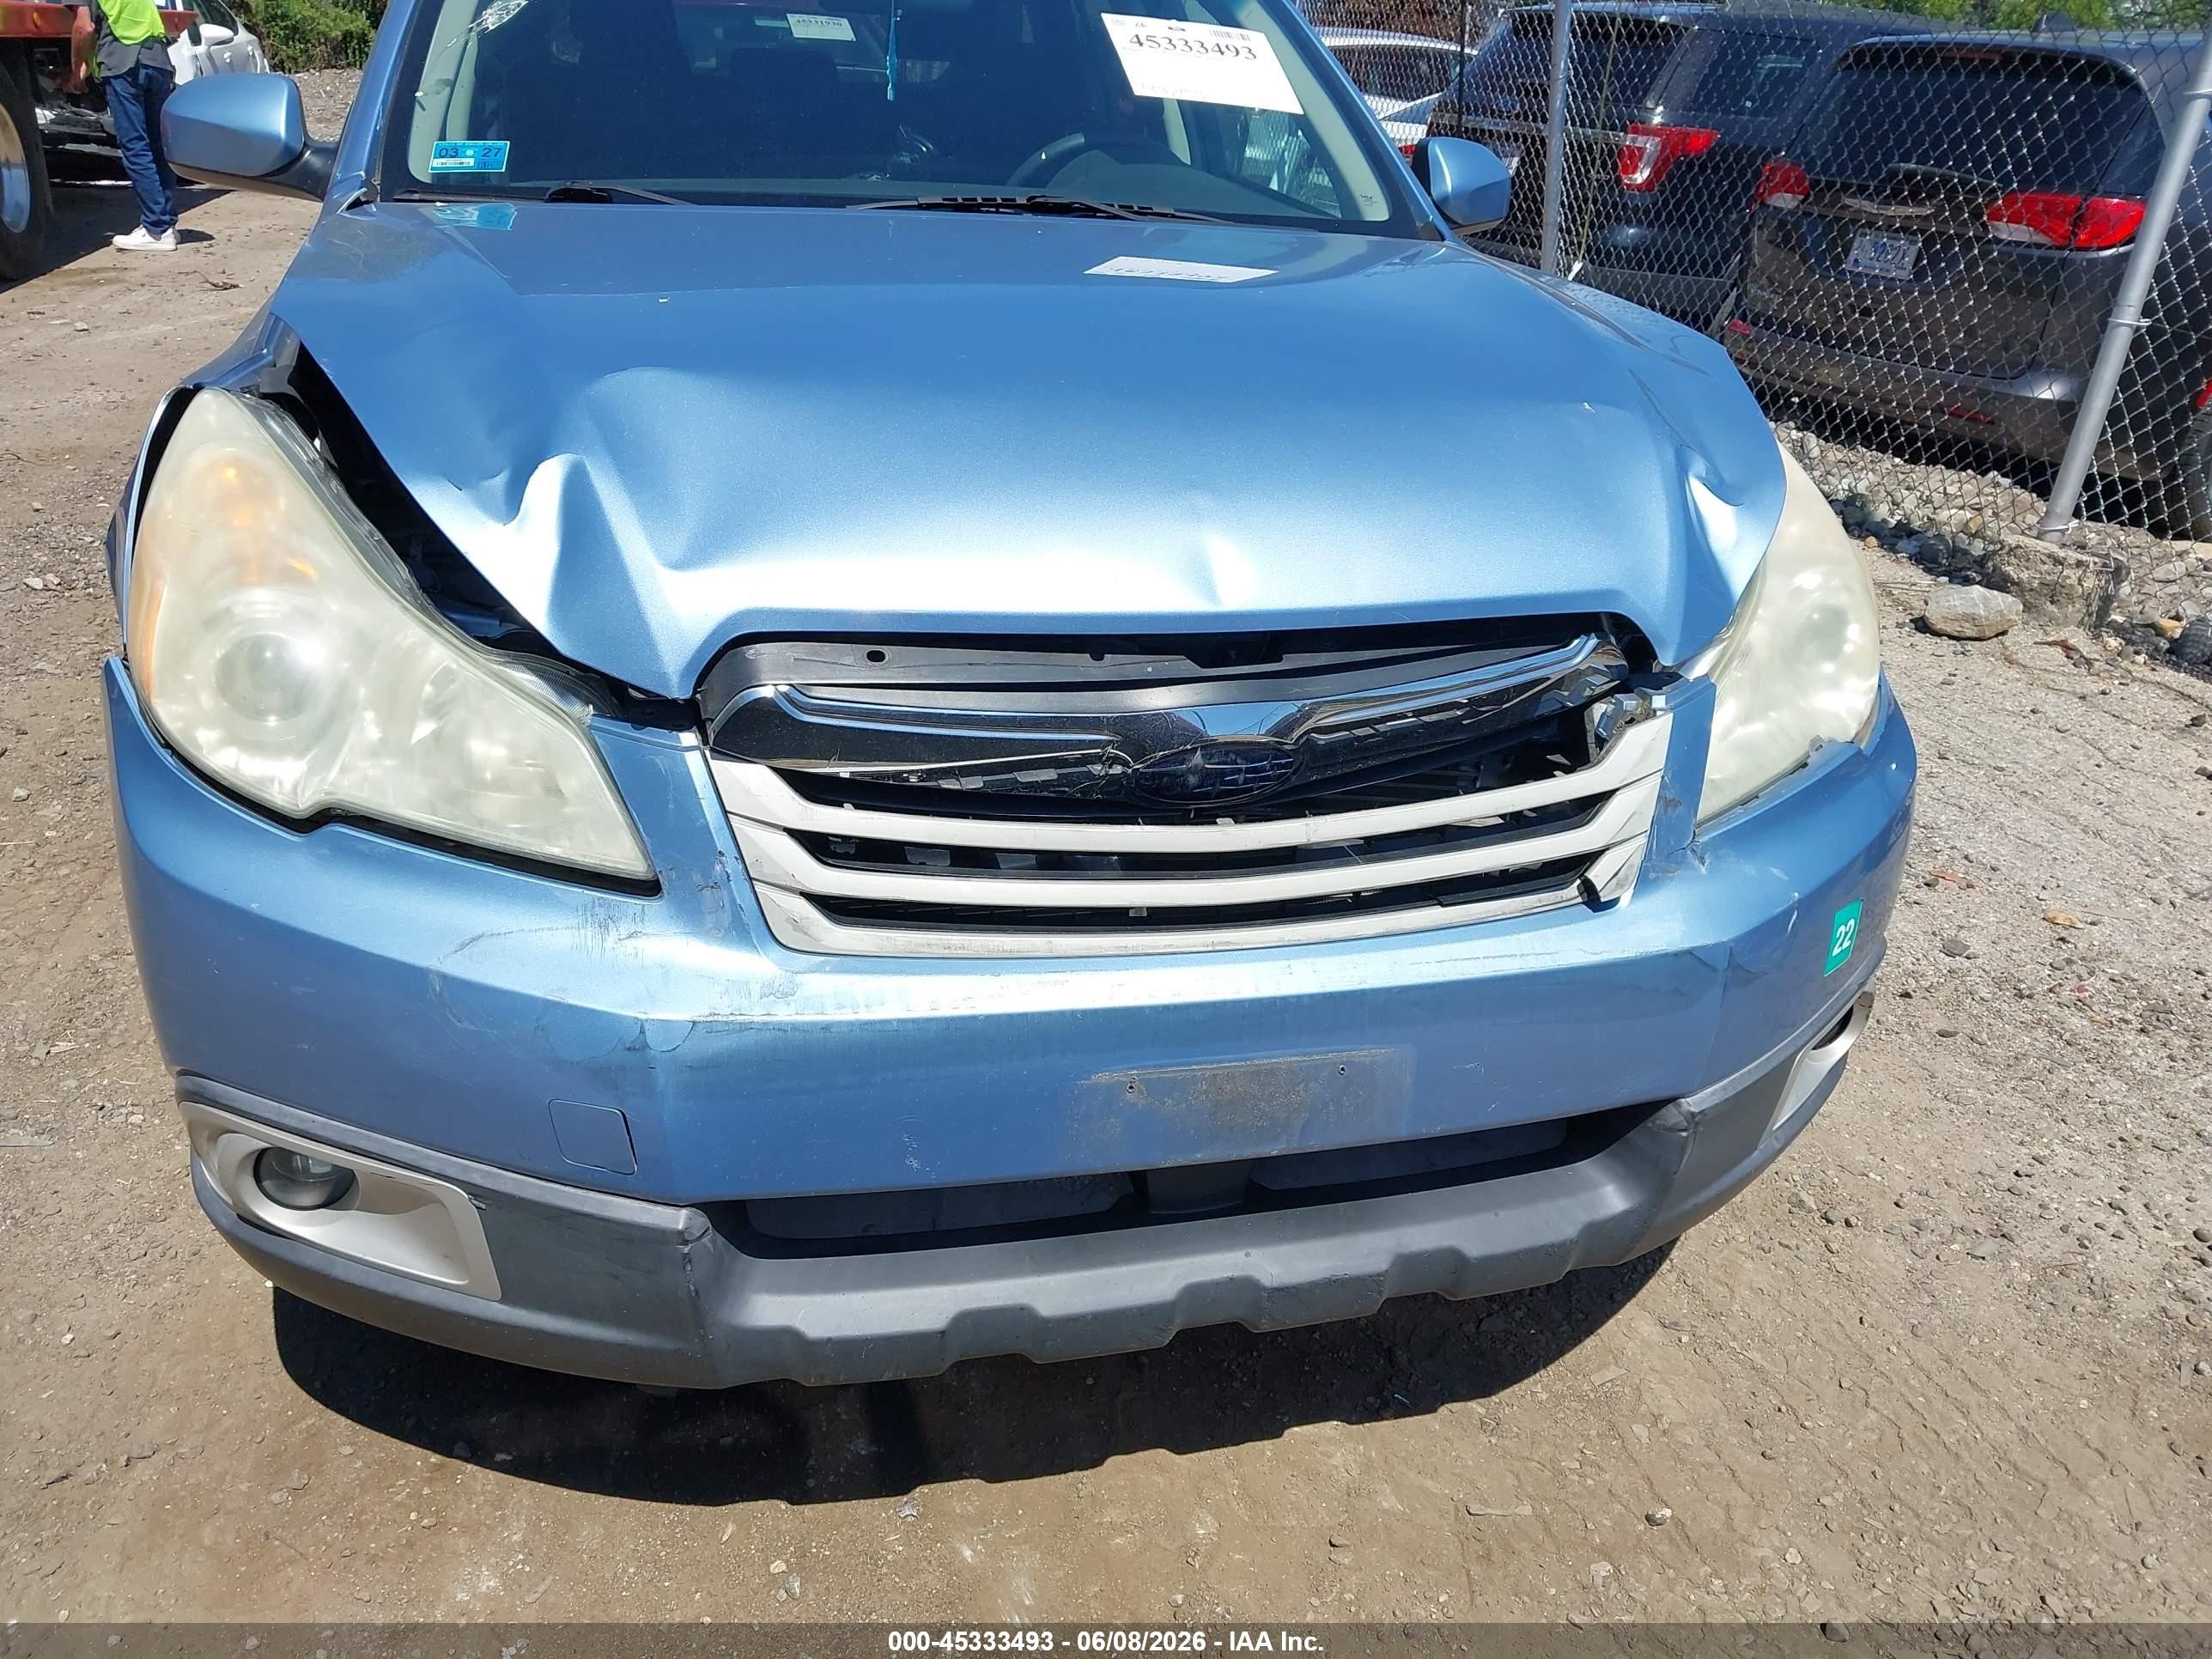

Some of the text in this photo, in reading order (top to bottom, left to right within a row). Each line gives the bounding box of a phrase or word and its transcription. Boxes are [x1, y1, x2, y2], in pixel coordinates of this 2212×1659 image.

[1128, 33, 1257, 61] 45333493
[438, 147, 503, 158] 03 27
[1832, 918, 1856, 957] 22
